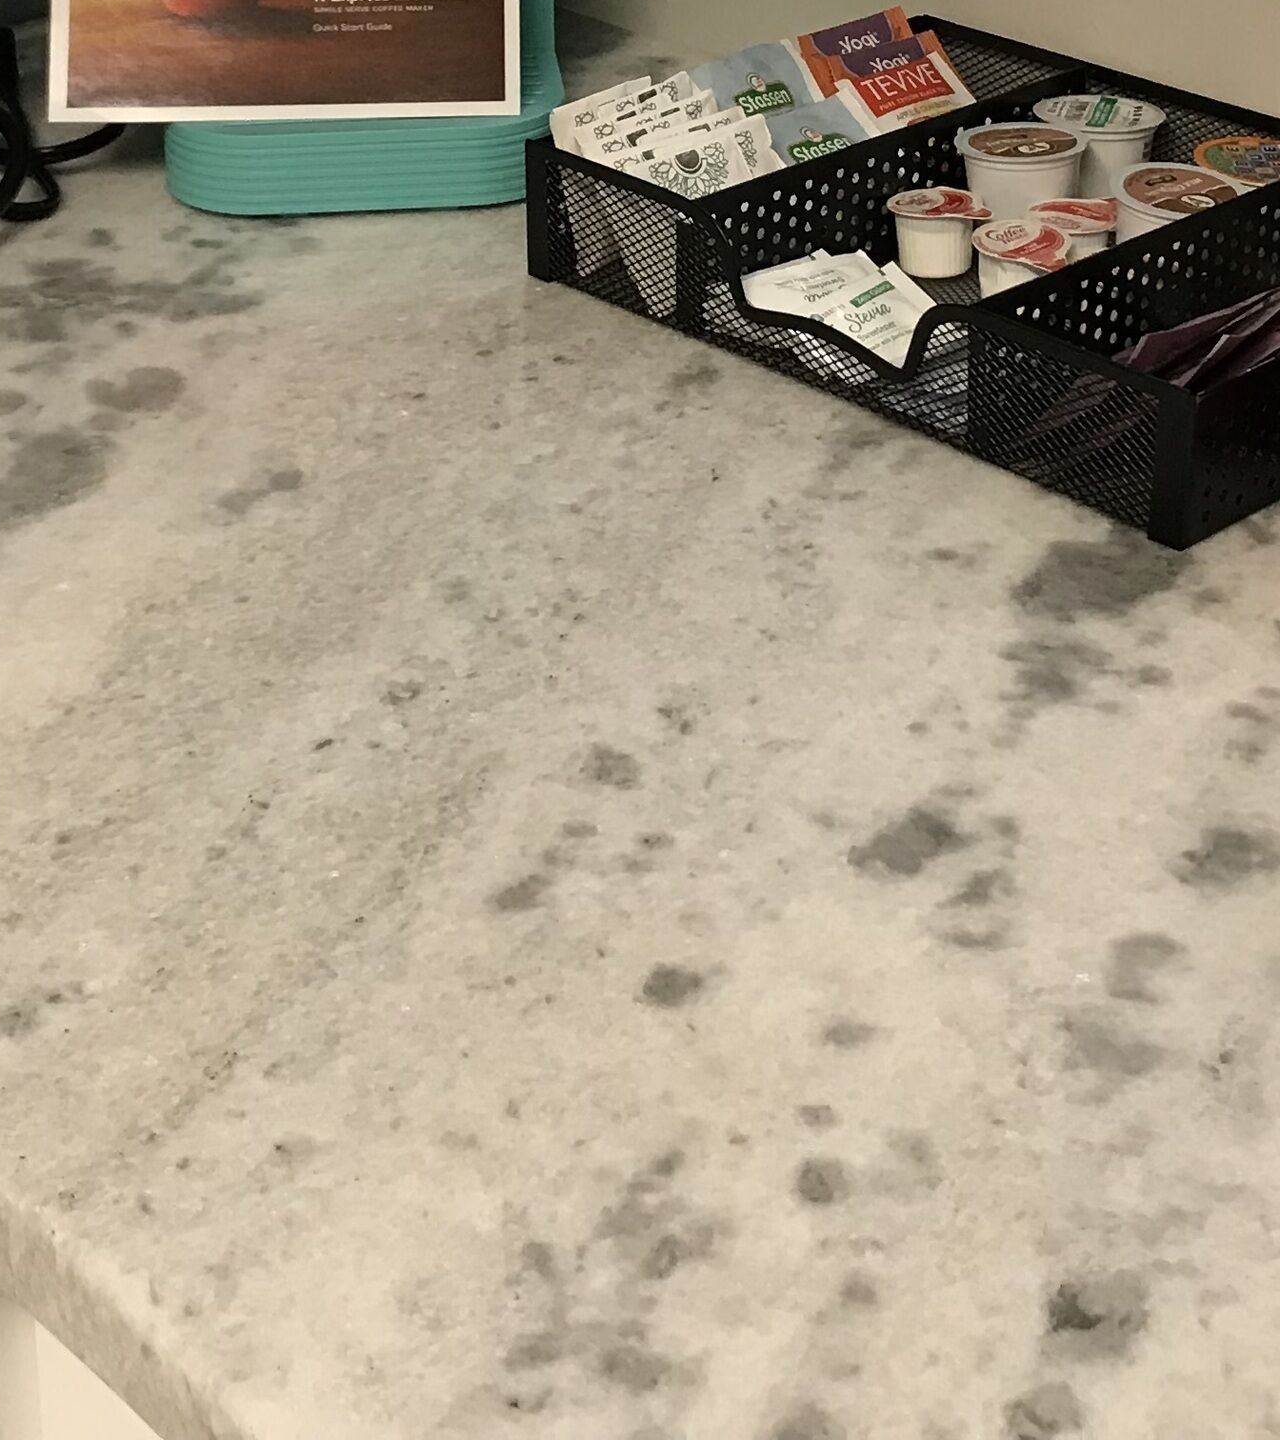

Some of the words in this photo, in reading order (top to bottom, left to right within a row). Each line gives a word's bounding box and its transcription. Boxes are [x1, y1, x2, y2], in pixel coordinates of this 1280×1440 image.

[340, 22, 364, 32] Start
[738, 88, 792, 114] Stassen
[843, 301, 892, 333] Stevia
